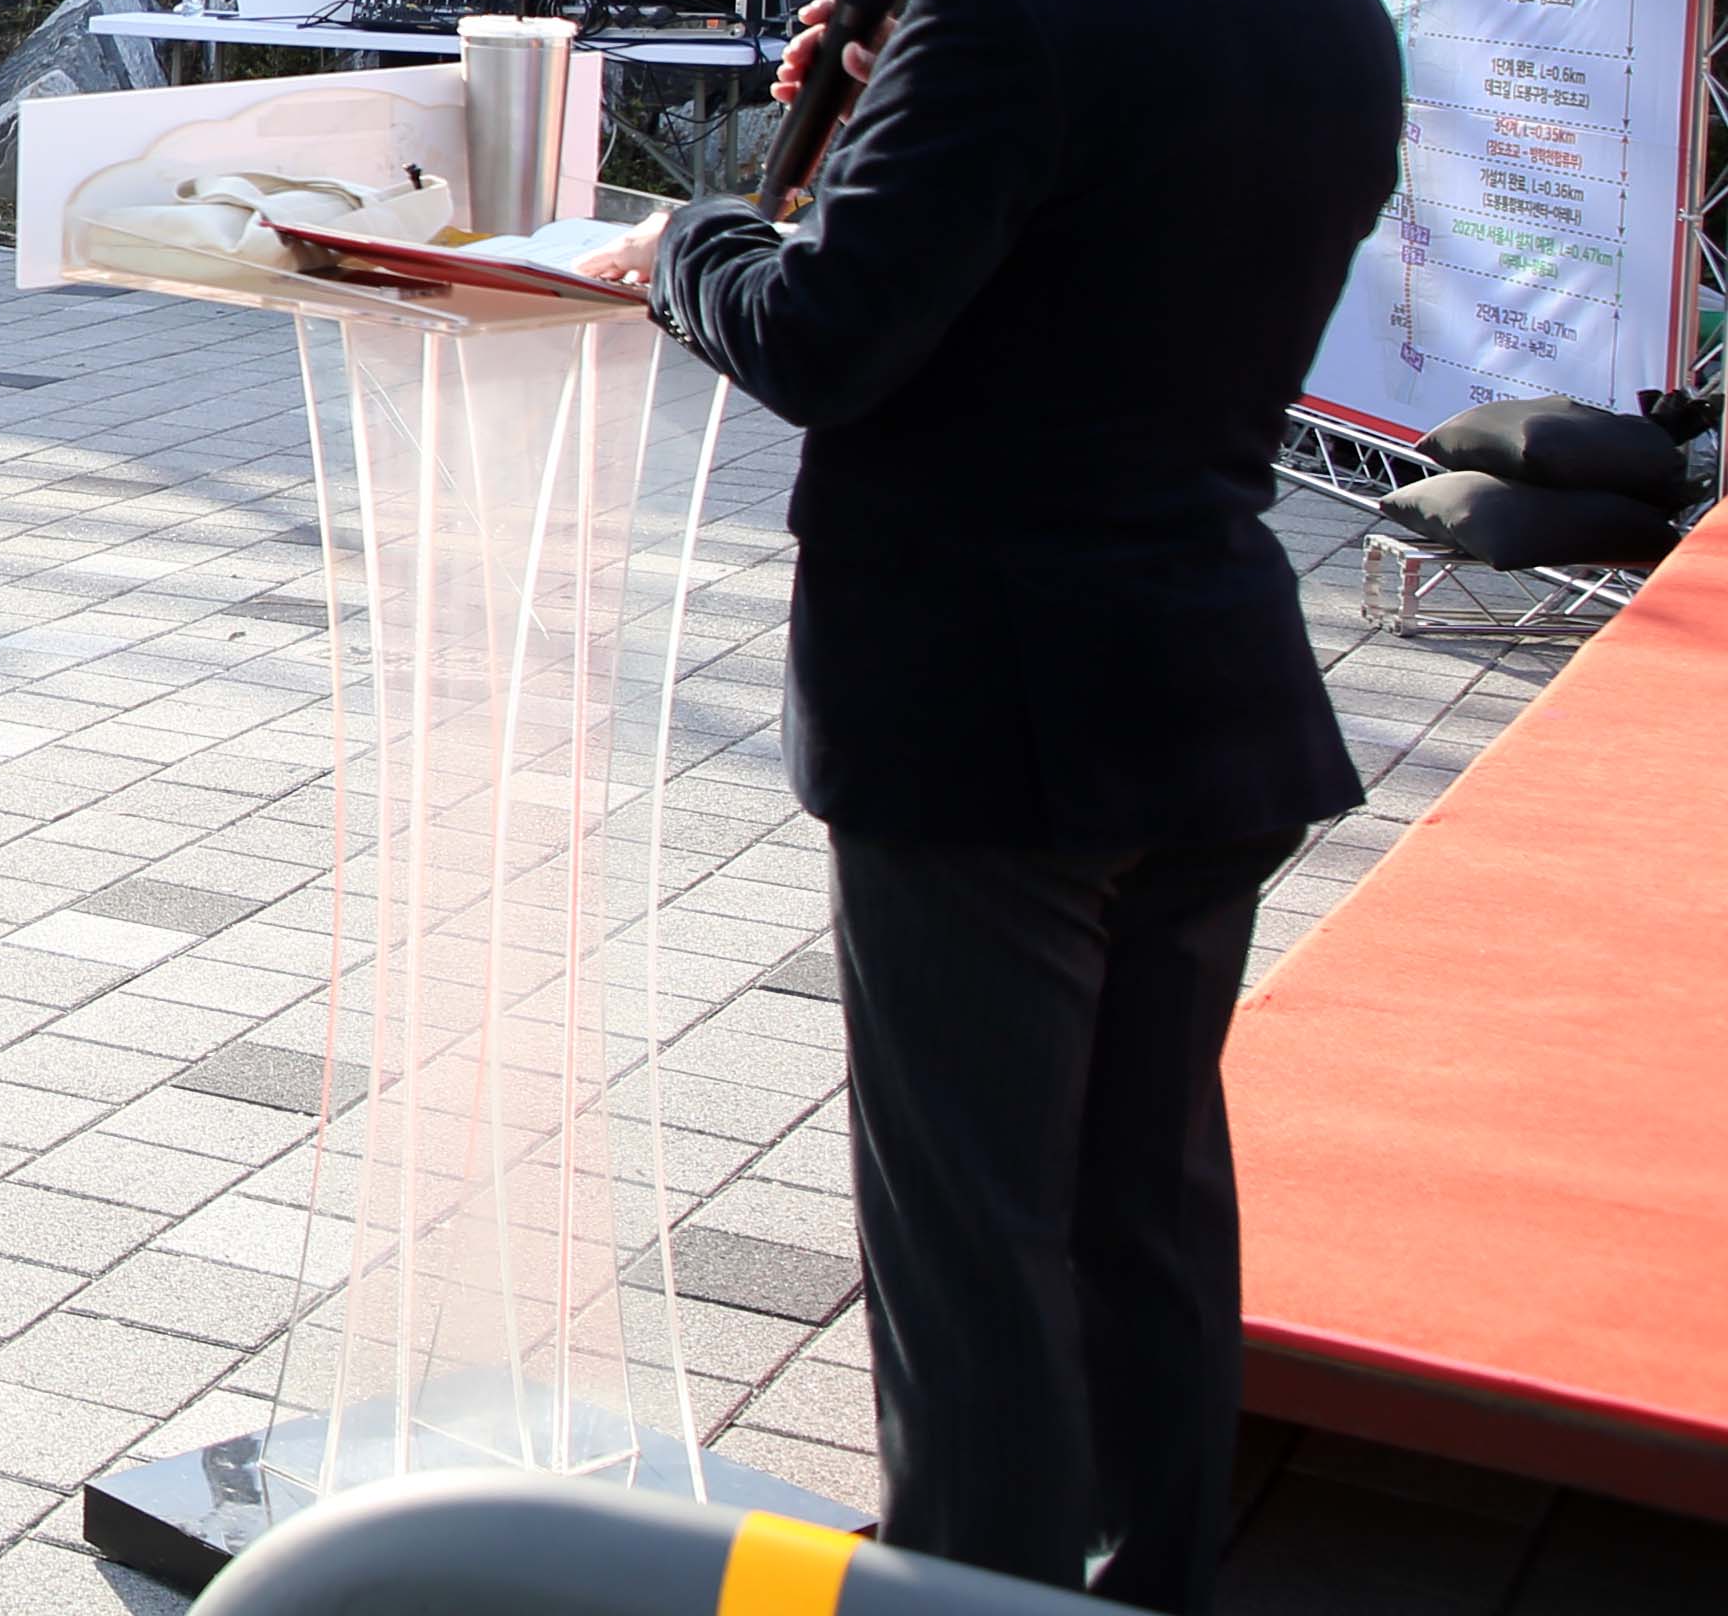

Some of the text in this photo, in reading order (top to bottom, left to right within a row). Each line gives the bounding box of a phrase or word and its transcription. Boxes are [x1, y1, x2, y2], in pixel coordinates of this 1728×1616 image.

[1492, 58, 1514, 77] 1단계
[1540, 65, 1586, 84] L=0.6km
[1484, 79, 1511, 99] 데크길
[1524, 124, 1575, 145] L=0.35km
[1480, 168, 1506, 188] 가설치
[1532, 179, 1584, 201] L=0.36km
[1452, 219, 1485, 240] 2027년
[1487, 225, 1513, 245] 서울시
[1515, 231, 1534, 252] 설치
[1560, 241, 1613, 266] L=0.47km
[1476, 304, 1501, 324] 2단계
[1531, 316, 1577, 341] L=0.7km
